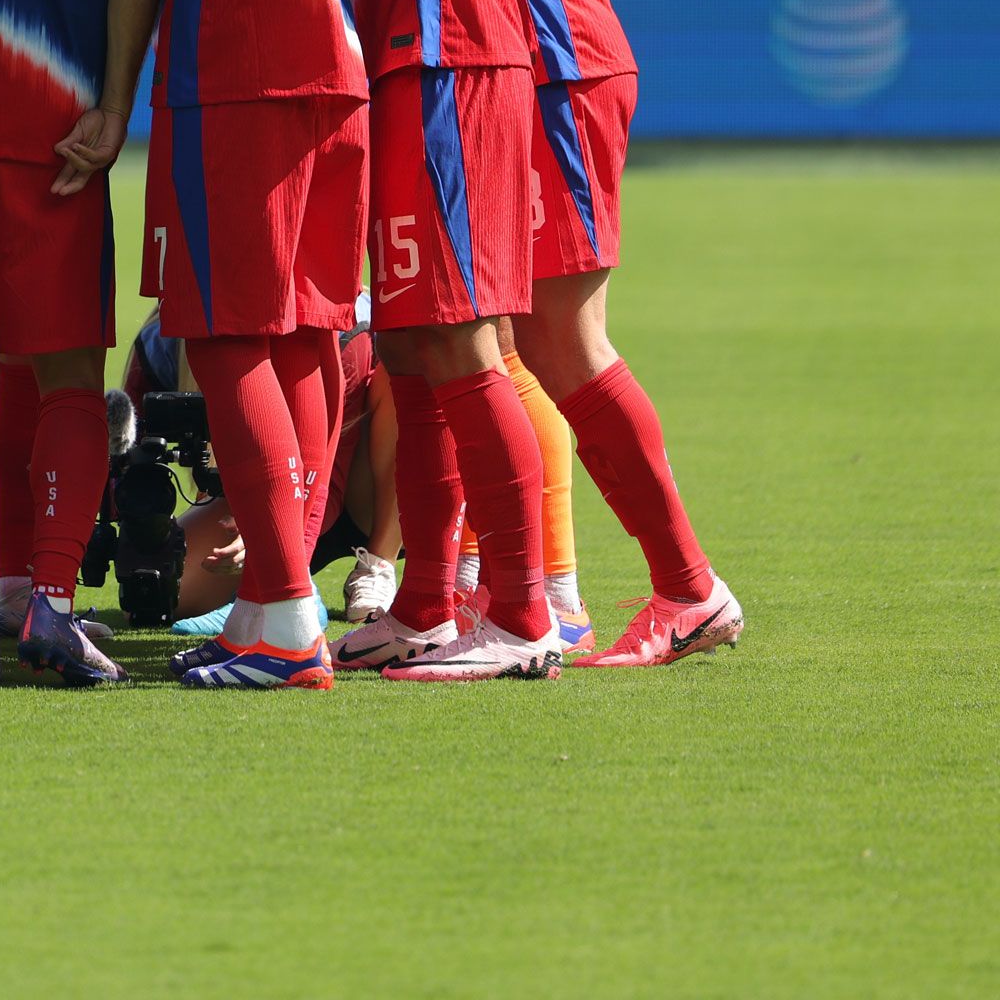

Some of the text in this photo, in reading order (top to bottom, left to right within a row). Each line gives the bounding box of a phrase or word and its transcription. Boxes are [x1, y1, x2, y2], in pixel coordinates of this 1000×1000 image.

[154, 226, 168, 291] 7
[374, 214, 421, 283] 15
[45, 471, 57, 518] USA
[287, 456, 302, 500] USA
